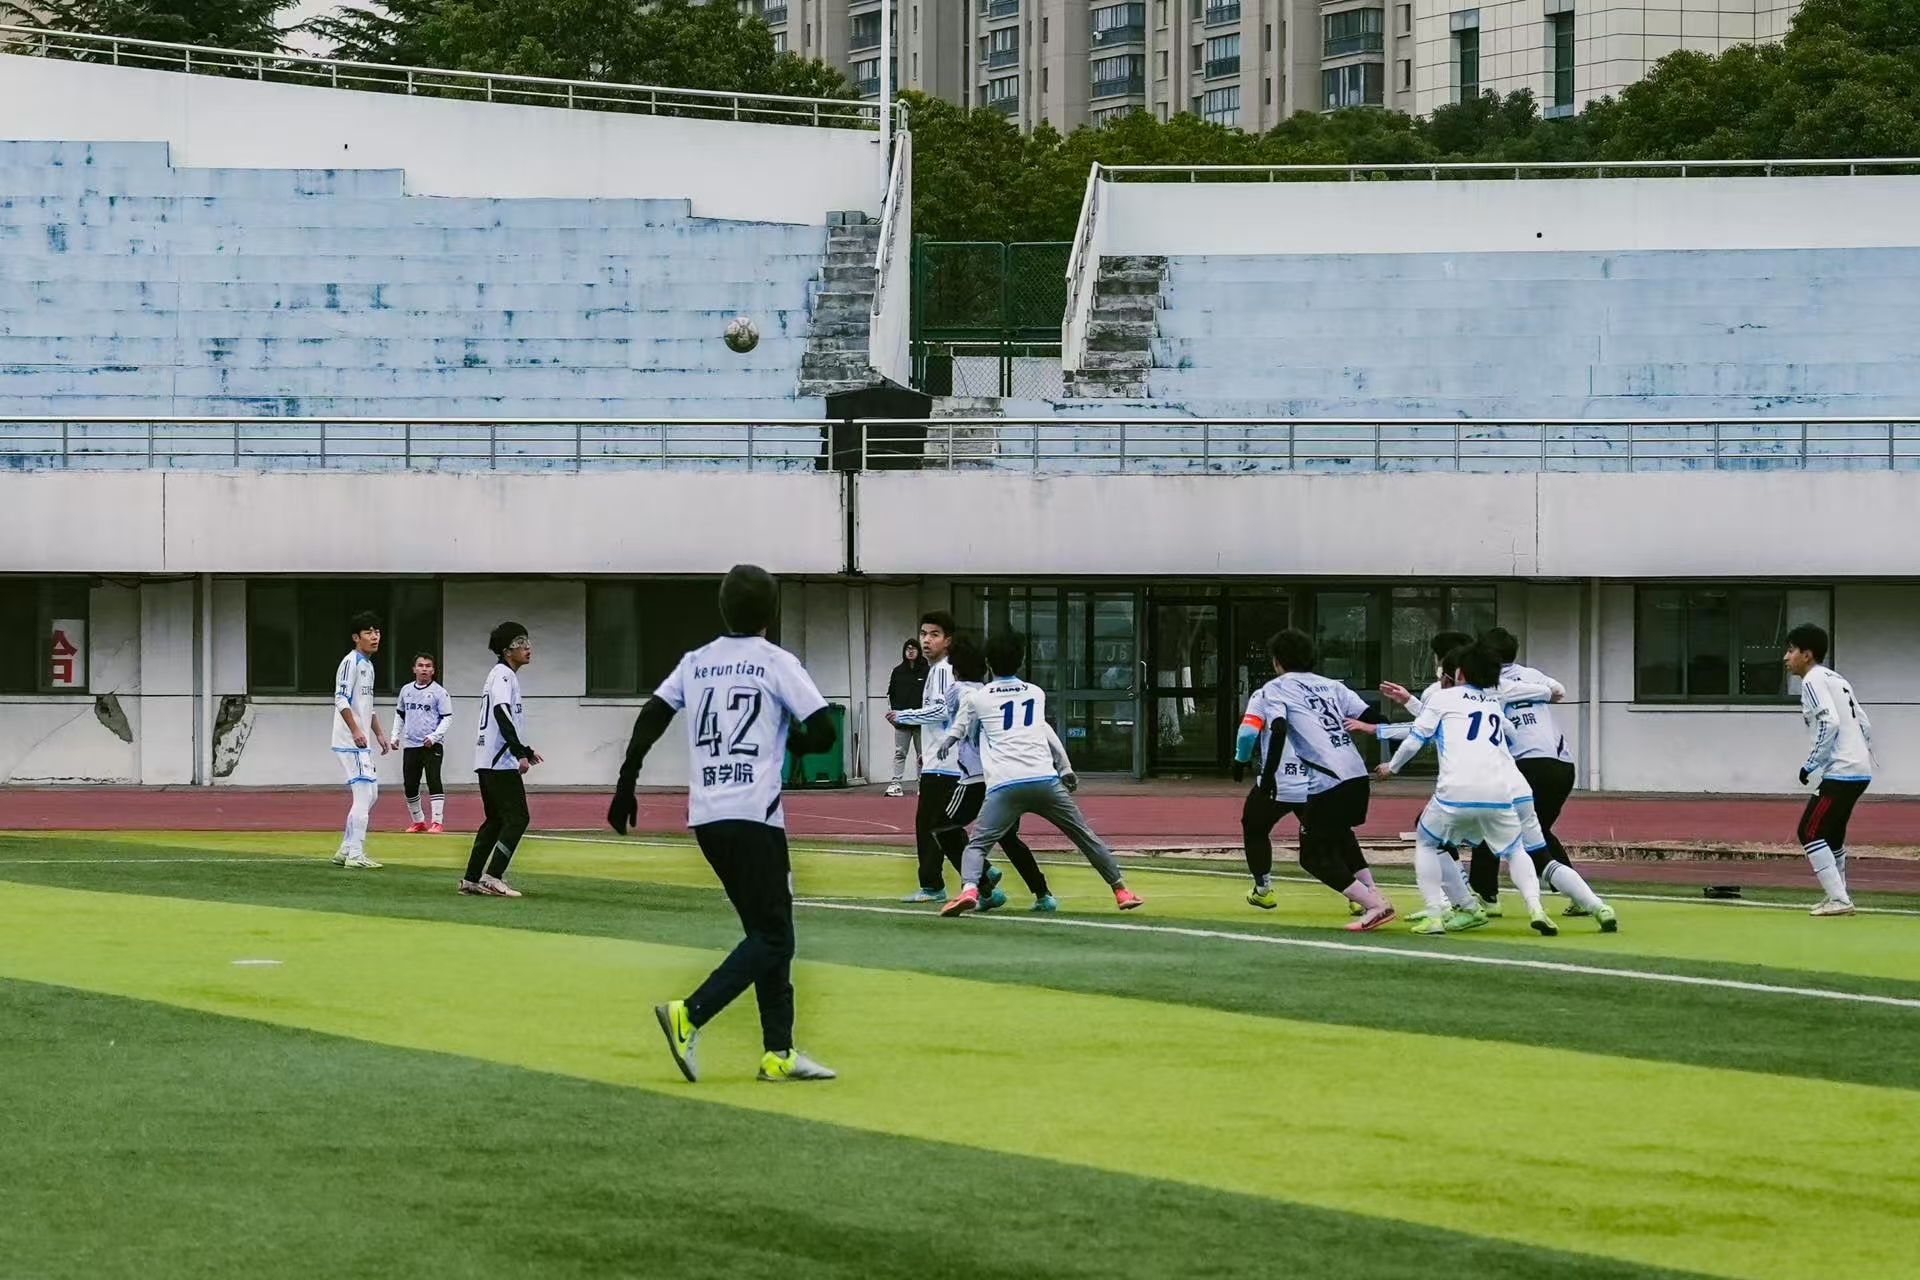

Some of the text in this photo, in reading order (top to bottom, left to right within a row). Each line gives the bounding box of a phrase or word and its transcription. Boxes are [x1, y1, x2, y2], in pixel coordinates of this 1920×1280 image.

[695, 686, 761, 757] 42
[1000, 699, 1035, 731] 11
[1467, 711, 1502, 746] 12
[702, 762, 754, 787] 商学院
